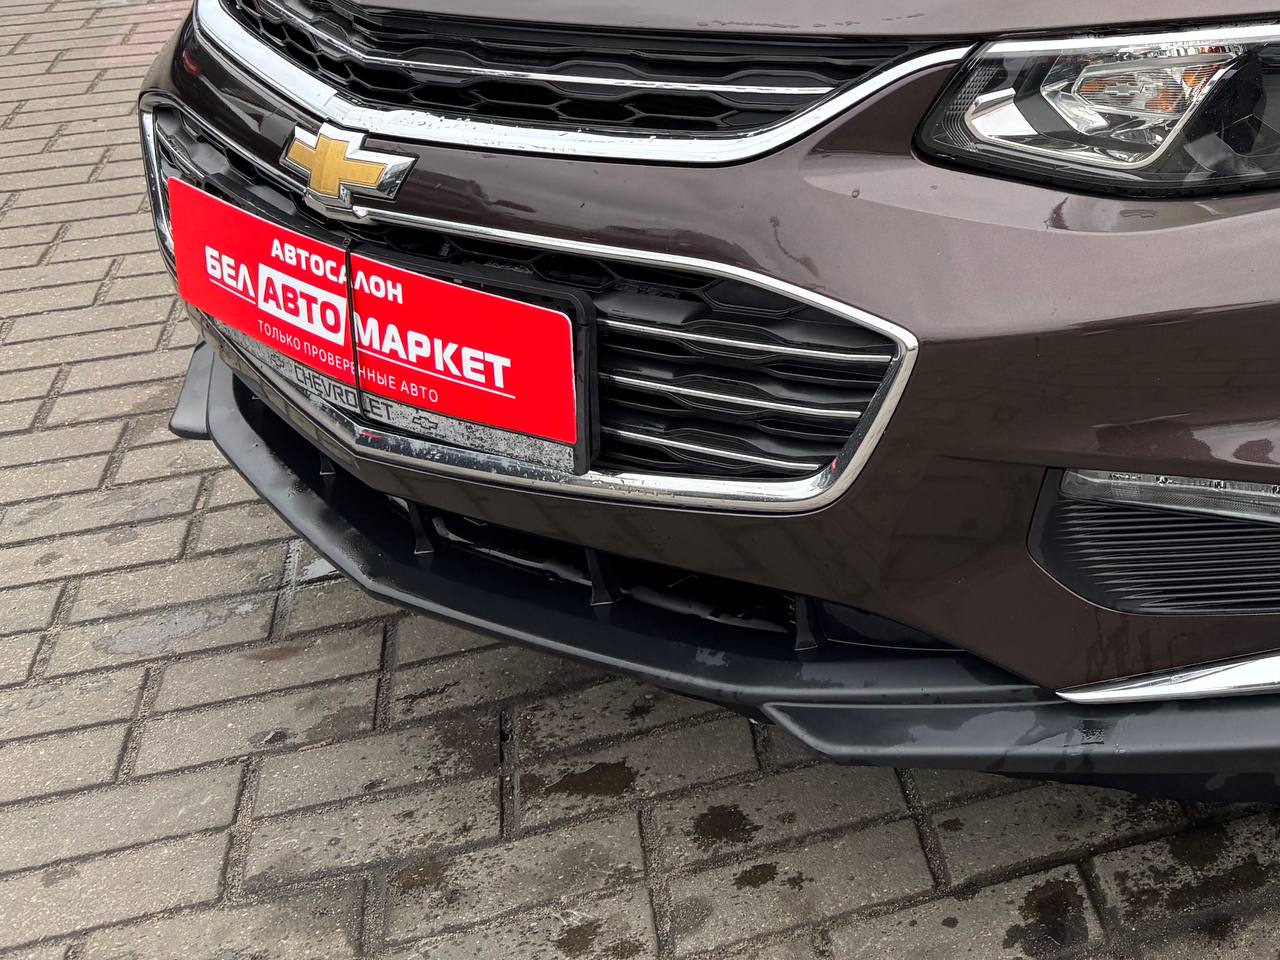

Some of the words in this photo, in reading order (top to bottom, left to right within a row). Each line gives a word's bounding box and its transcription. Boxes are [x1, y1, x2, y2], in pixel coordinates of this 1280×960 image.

[271, 238, 403, 305] АВТОСАЛОН
[257, 319, 301, 351] ТОЛЬКО
[304, 341, 396, 390] ПРОВЕРЕННЫЕ
[400, 380, 438, 403] АВТО
